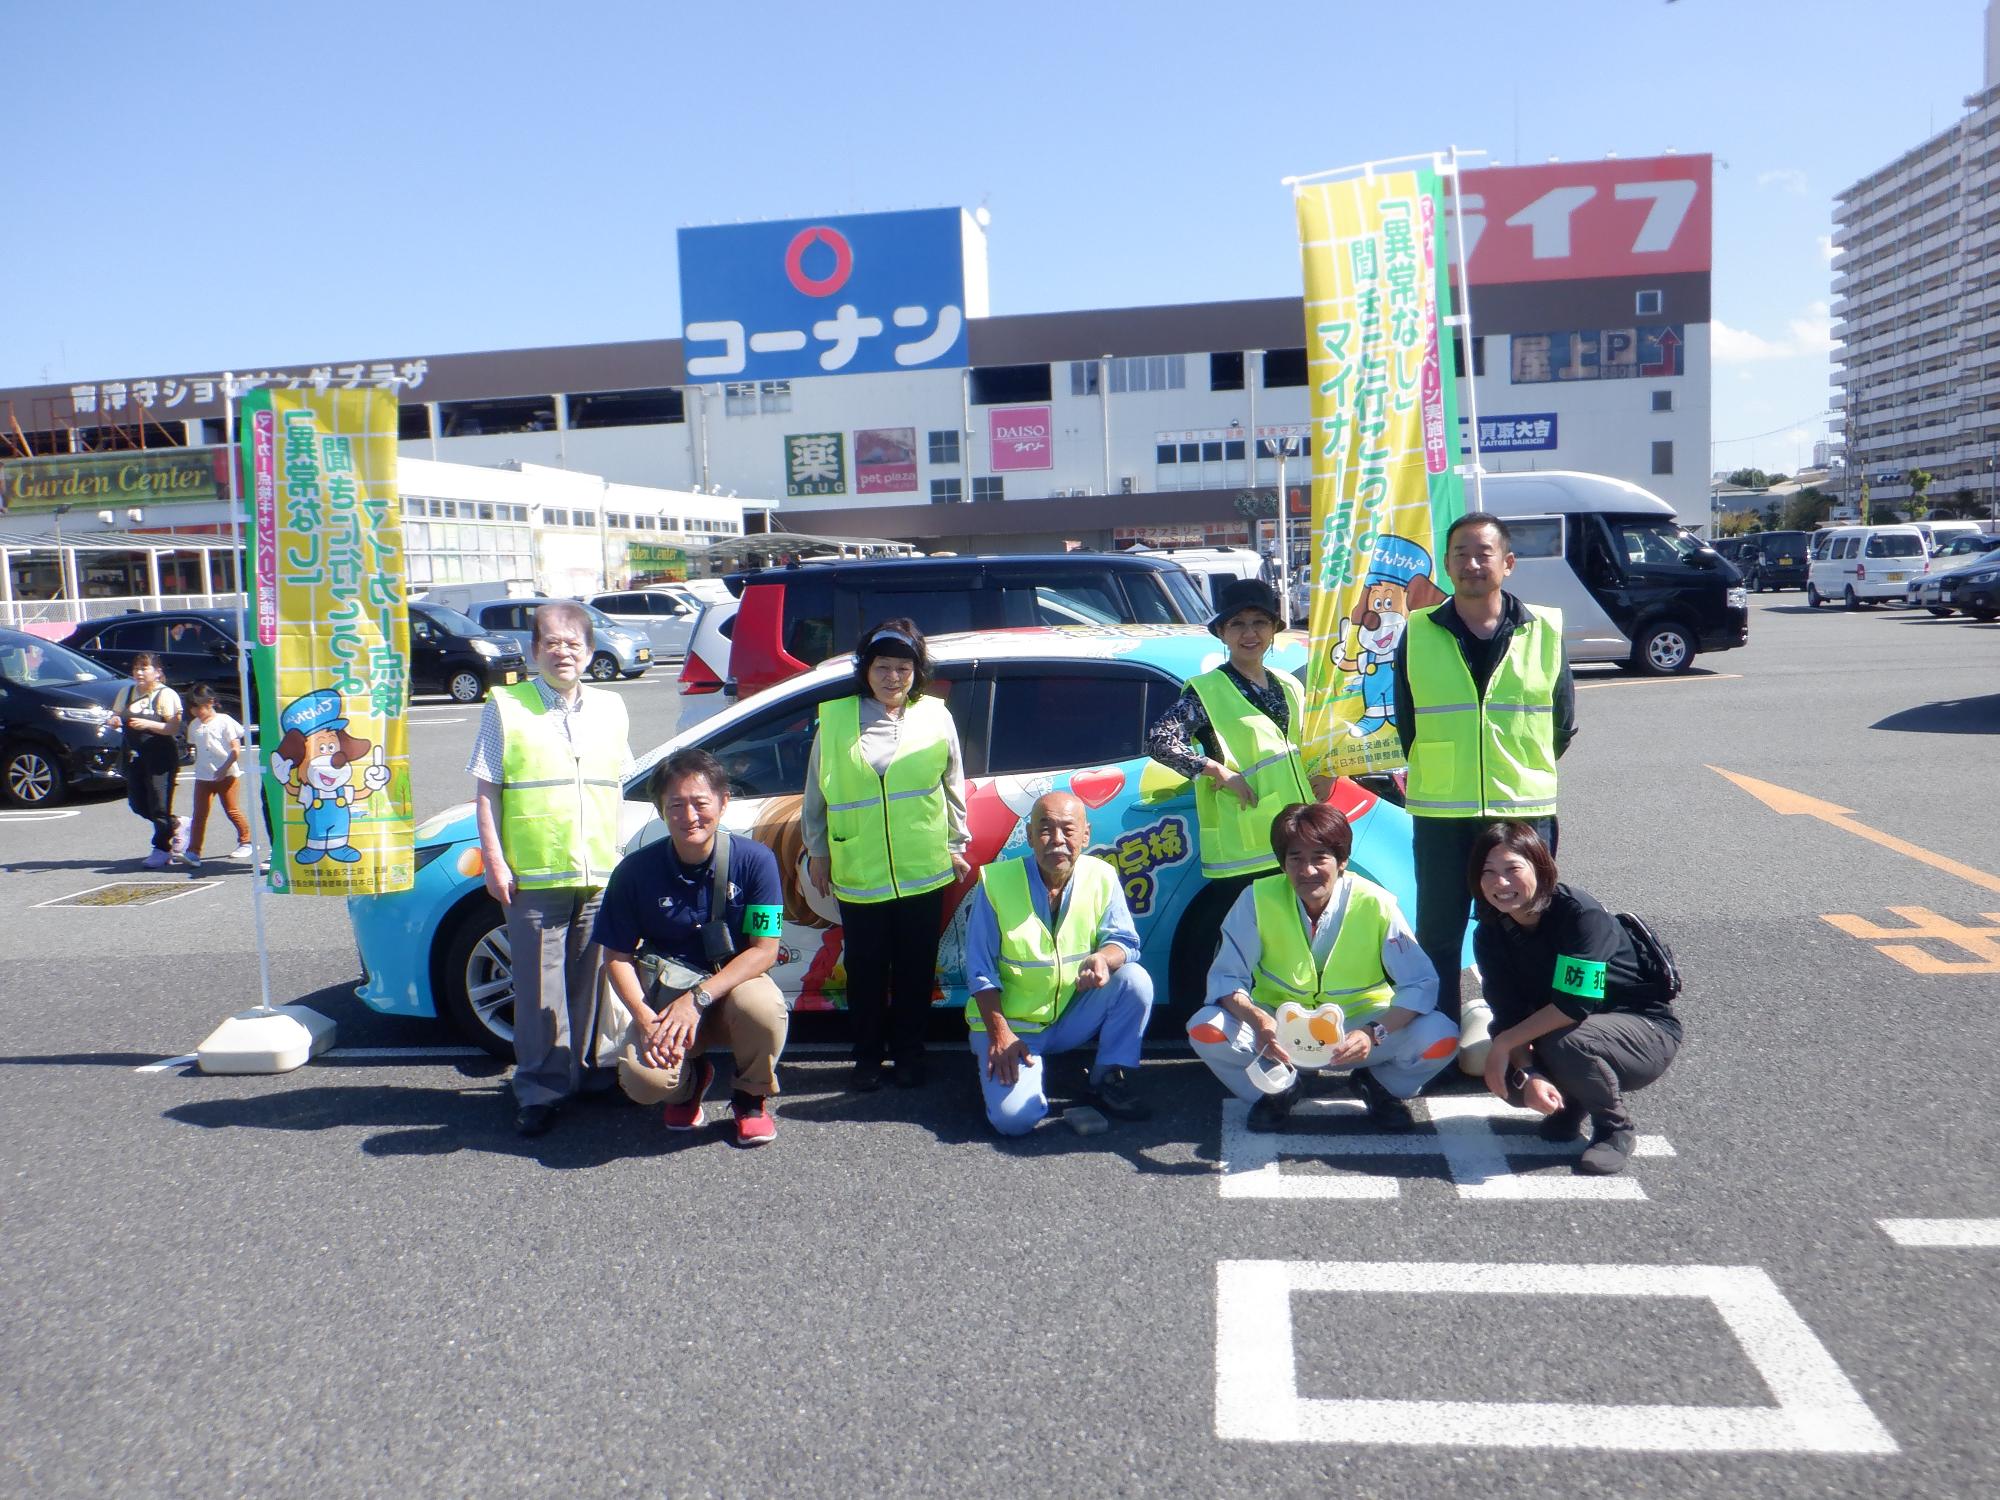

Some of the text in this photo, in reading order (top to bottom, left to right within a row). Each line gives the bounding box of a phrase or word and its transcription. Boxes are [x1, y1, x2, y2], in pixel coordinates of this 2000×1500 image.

[686, 304, 961, 376] コーナン
[996, 425, 1044, 438] DAISO
[1479, 420, 1551, 440] 買取大吉
[1013, 441, 1045, 453] ダイソー
[1512, 438, 1545, 446] DAIKICHI
[791, 436, 839, 481] 薬
[14, 463, 208, 498] Garden Center
[788, 481, 844, 495] DRUG
[860, 473, 882, 489] pet
[884, 472, 916, 485] plaza
[1340, 750, 1405, 768] 日本自動車整備
